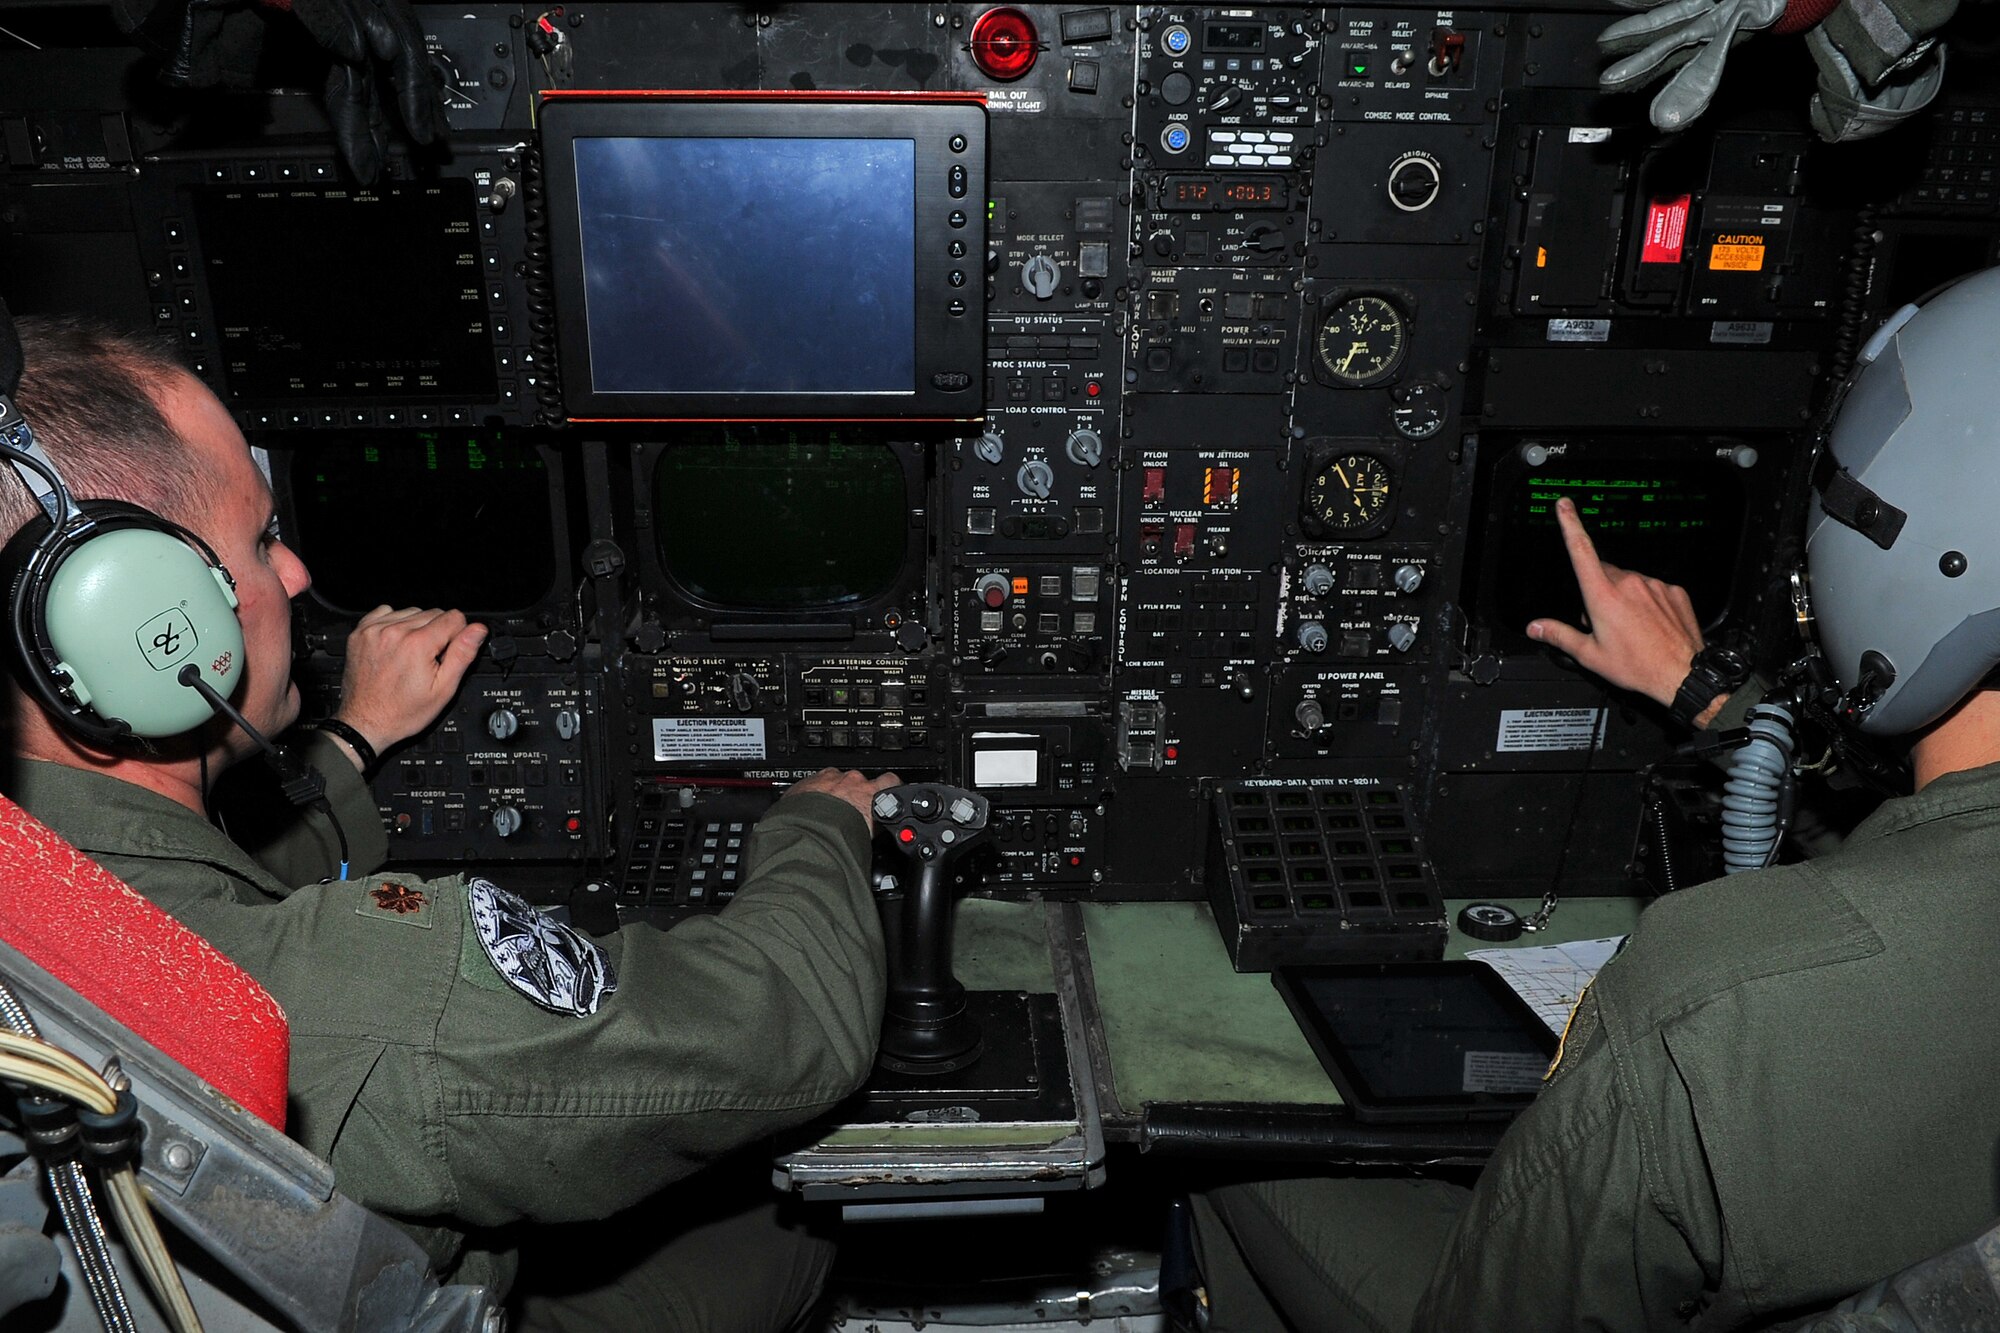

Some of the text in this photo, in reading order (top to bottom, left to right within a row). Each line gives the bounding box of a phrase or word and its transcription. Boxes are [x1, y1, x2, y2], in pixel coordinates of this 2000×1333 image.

[1403, 151, 1430, 159] BRIGHT
[1654, 213, 1664, 243] SECRET
[1718, 235, 1763, 244] CAUTION
[1564, 321, 1594, 330] A9632
[1349, 457, 1355, 467] 0
[1319, 476, 1325, 485] 8
[1374, 473, 1380, 483] 2
[1318, 495, 1324, 504] 7
[1372, 498, 1378, 506] 3
[1326, 508, 1333, 517] 6
[1360, 508, 1367, 517] 4
[1343, 513, 1349, 523] 5
[1245, 778, 1307, 786] KEYBOARD-DATA
